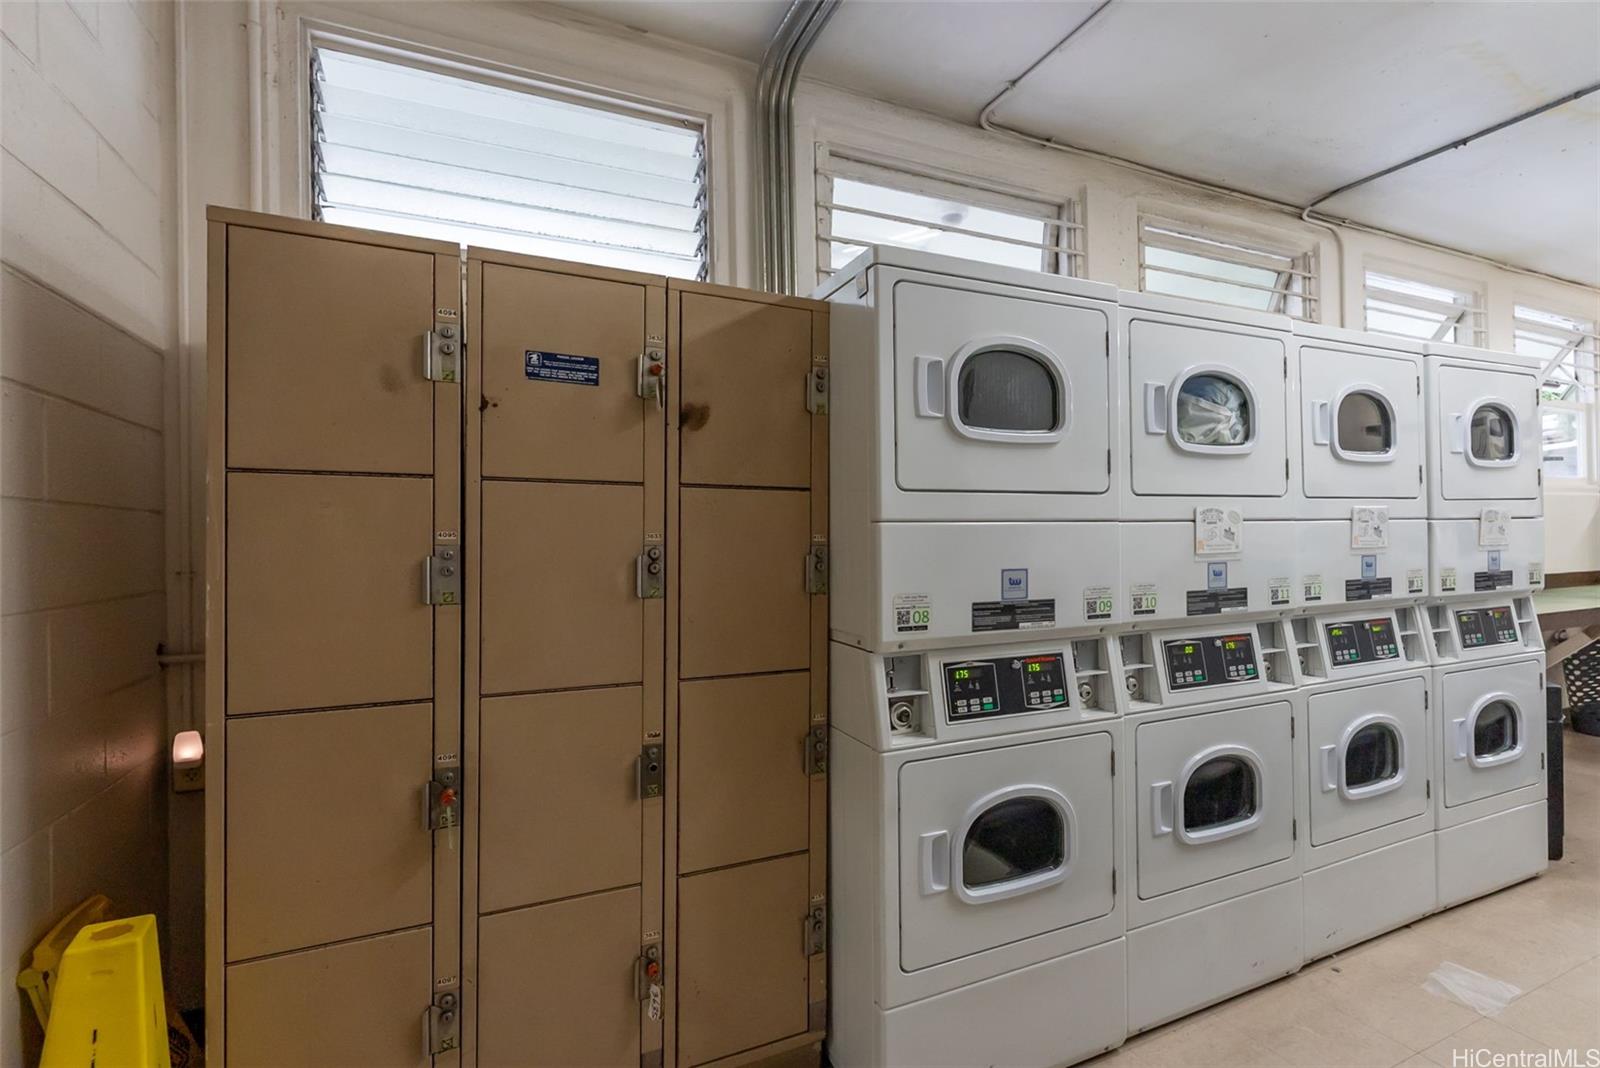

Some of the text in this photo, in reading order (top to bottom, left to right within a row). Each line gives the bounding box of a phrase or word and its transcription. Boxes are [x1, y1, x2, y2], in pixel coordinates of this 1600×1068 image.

[438, 308, 457, 317] 4094
[438, 531, 457, 539] 4095
[1280, 589, 1290, 599] 11
[1099, 600, 1113, 613] 09
[1144, 597, 1157, 609] 10
[912, 610, 930, 624] 08
[438, 754, 457, 762] 4096
[437, 976, 456, 985] 4097
